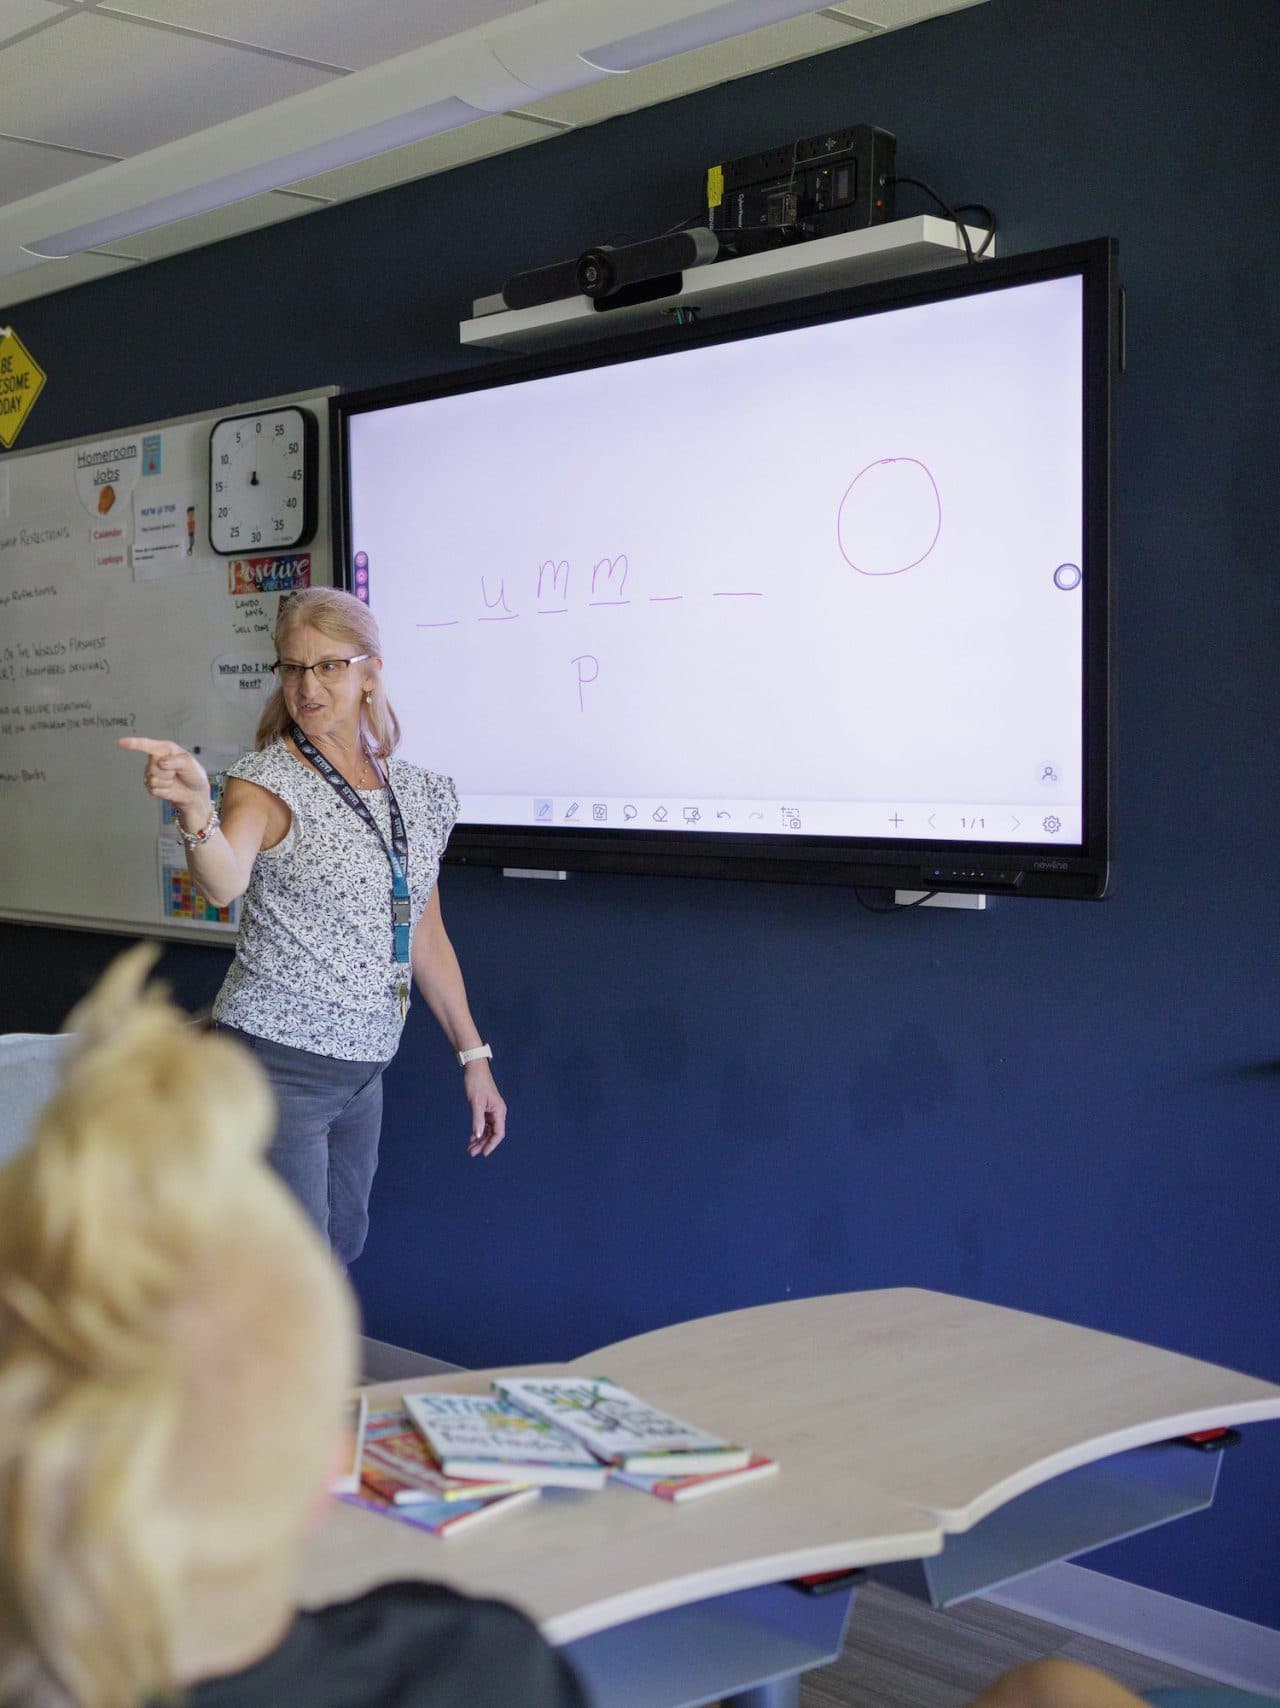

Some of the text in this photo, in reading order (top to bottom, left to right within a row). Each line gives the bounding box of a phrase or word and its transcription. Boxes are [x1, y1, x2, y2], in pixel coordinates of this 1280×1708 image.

[1, 356, 13, 374] BE
[255, 422, 262, 434] 0
[274, 424, 285, 437] 55
[236, 432, 241, 444] 5
[288, 442, 299, 455] 50
[77, 444, 137, 467] Homeroom
[221, 454, 229, 465] 10
[94, 468, 120, 485] Jobs
[291, 469, 302, 481] 45
[286, 497, 297, 509] 40
[218, 507, 228, 519] 20
[274, 519, 285, 532] 35
[230, 526, 240, 538] 25
[251, 531, 262, 544] 30
[230, 558, 310, 593] Positive
[219, 662, 240, 673] What
[241, 663, 253, 673] Do
[239, 679, 262, 690] Next?
